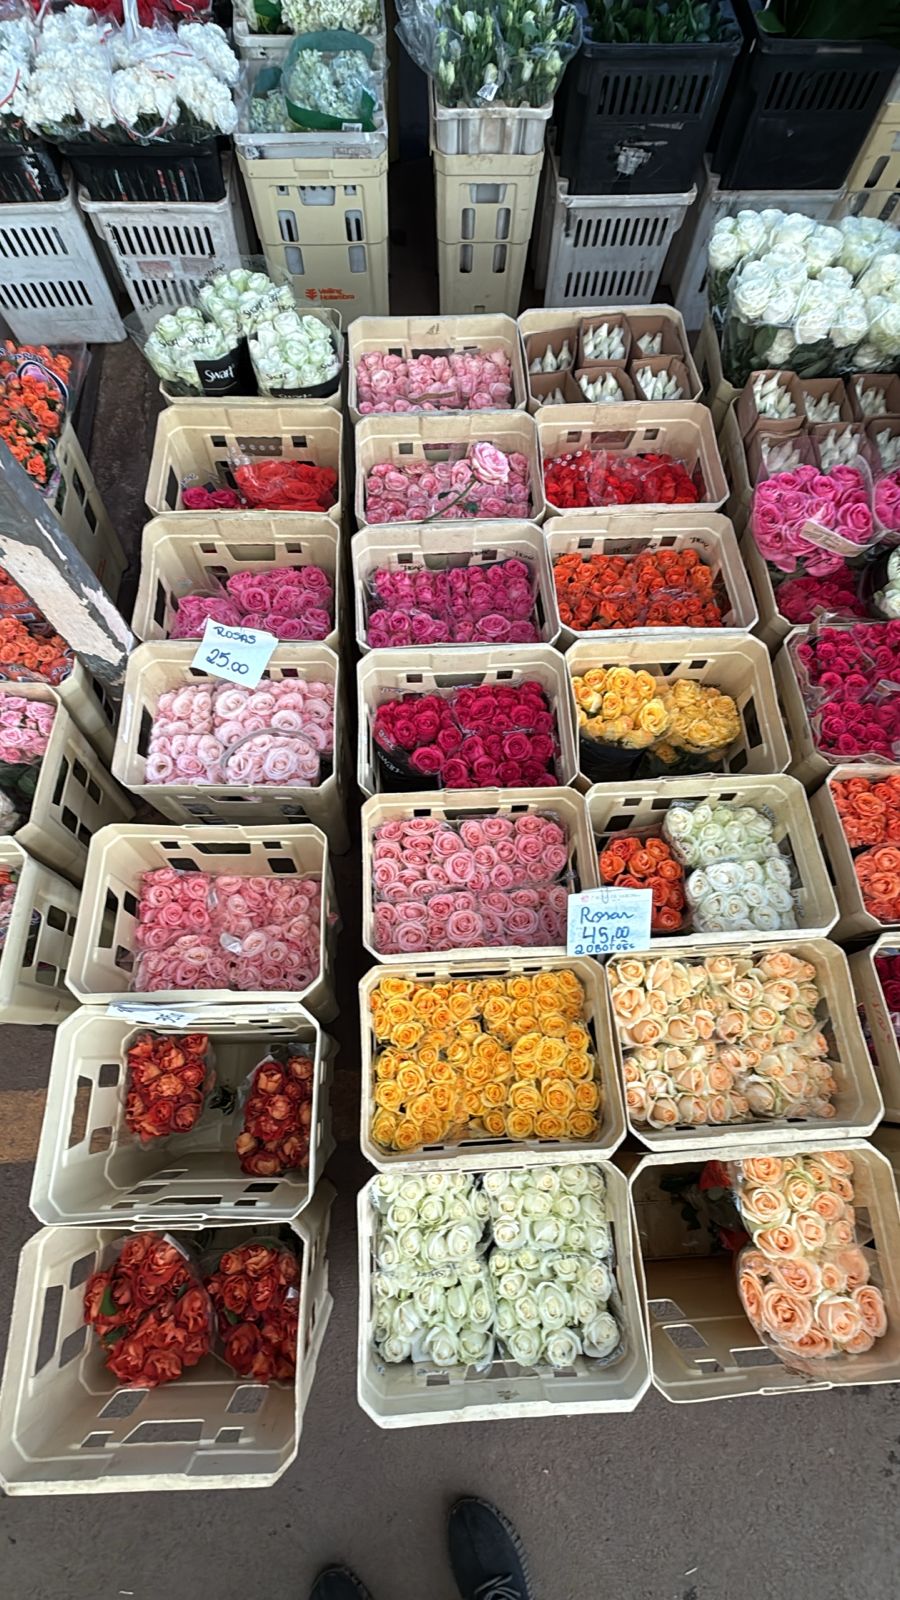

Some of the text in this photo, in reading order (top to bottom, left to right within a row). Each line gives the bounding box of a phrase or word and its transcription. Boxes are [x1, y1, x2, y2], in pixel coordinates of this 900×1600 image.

[204, 365, 235, 383] Swart
[213, 626, 257, 645] ROSAS
[206, 648, 249, 675] 25.00
[582, 926, 630, 944] 45,00
